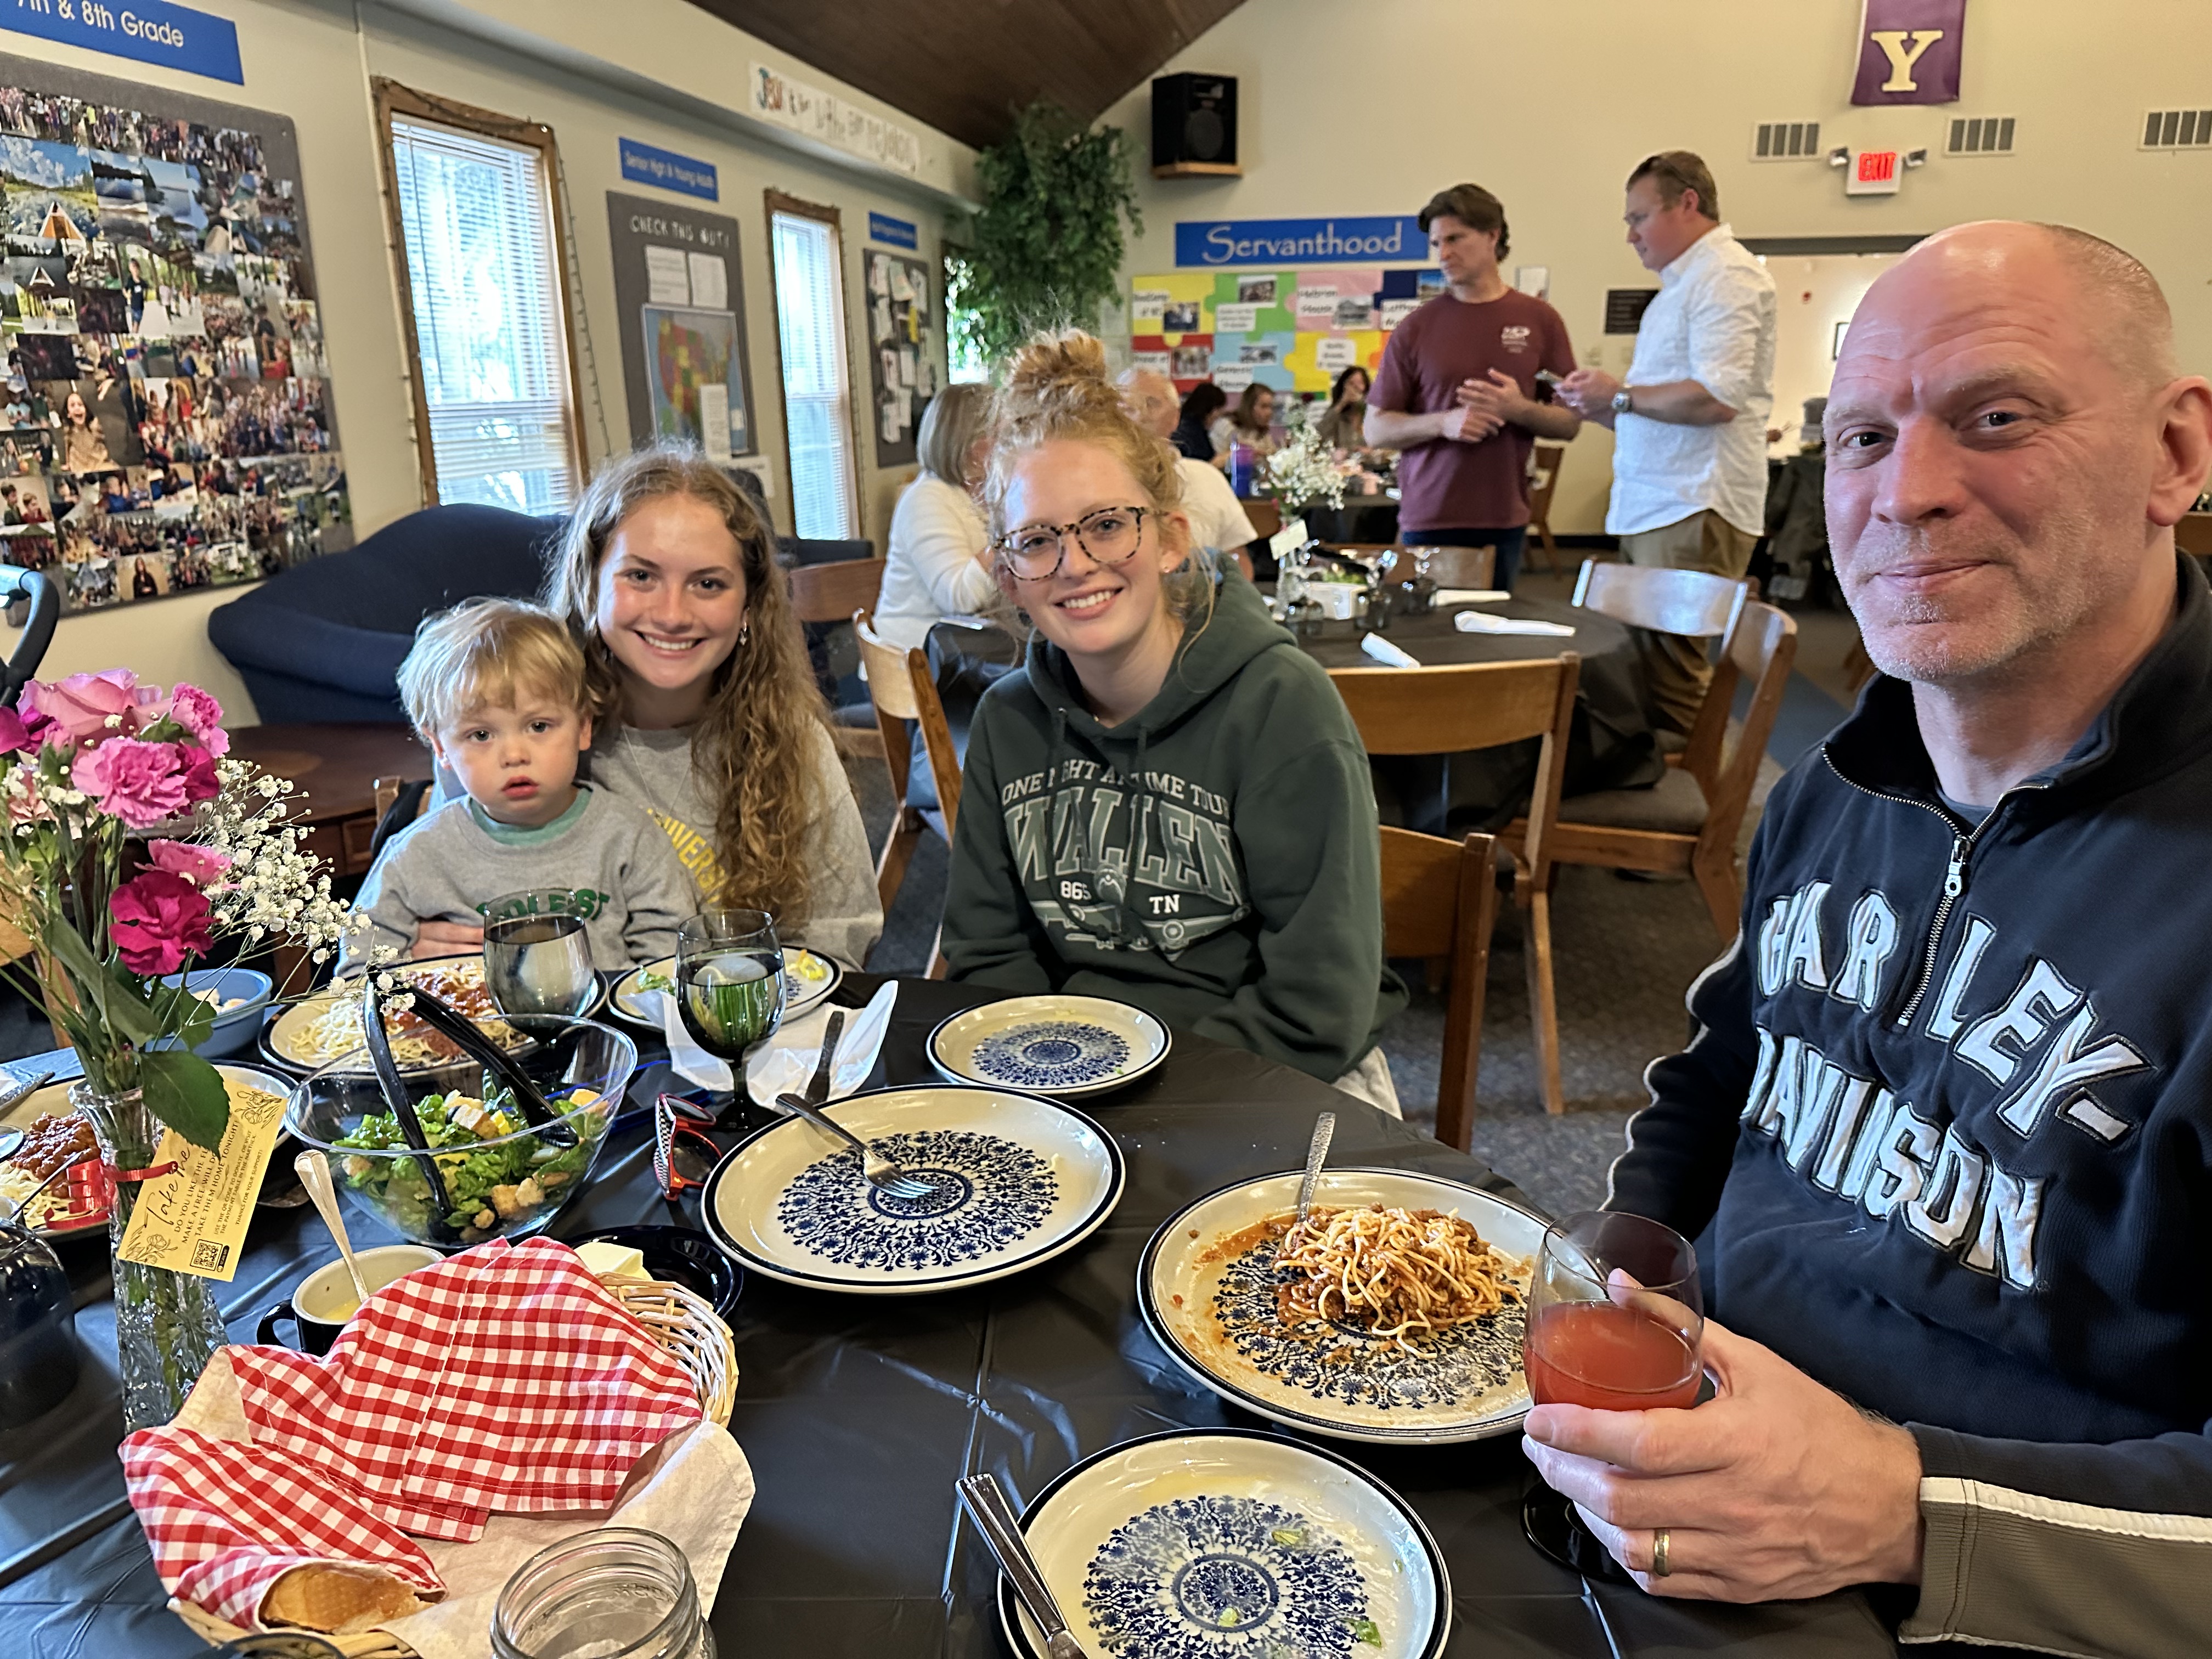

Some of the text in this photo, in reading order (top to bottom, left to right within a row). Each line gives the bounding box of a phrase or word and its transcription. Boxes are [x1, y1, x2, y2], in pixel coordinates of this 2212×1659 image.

[82, 1, 114, 31] 8th
[121, 11, 184, 47] Grade
[1870, 30, 1943, 92] Y
[630, 215, 668, 236] CHECK
[671, 221, 694, 242] THIS
[1202, 221, 1402, 263] Servanthood
[1002, 772, 1044, 806] ONE
[1005, 786, 1243, 906] WALLEN
[1060, 880, 1092, 900] 865
[1148, 894, 1180, 915] TN
[143, 1174, 178, 1226] Take
[174, 1218, 183, 1233] DO
[179, 1199, 190, 1216] YOU
[186, 1180, 198, 1197] LIKE
[193, 1161, 204, 1176] THE
[194, 1216, 207, 1236] TAKE
[202, 1189, 216, 1212] THEM
[211, 1161, 225, 1187] HOME
[221, 1120, 240, 1158] TONIGHT!
[224, 1187, 233, 1202] CODE
[224, 1197, 235, 1222] PAYMENT
[232, 1180, 241, 1195] TABLE
[235, 1204, 246, 1224] THANKS
[246, 1176, 255, 1190] YOUR
[251, 1149, 263, 1175] SUPPORT!
[182, 1219, 195, 1243] MAKE
[193, 1188, 205, 1209] FREE
[201, 1166, 213, 1184] WILL
